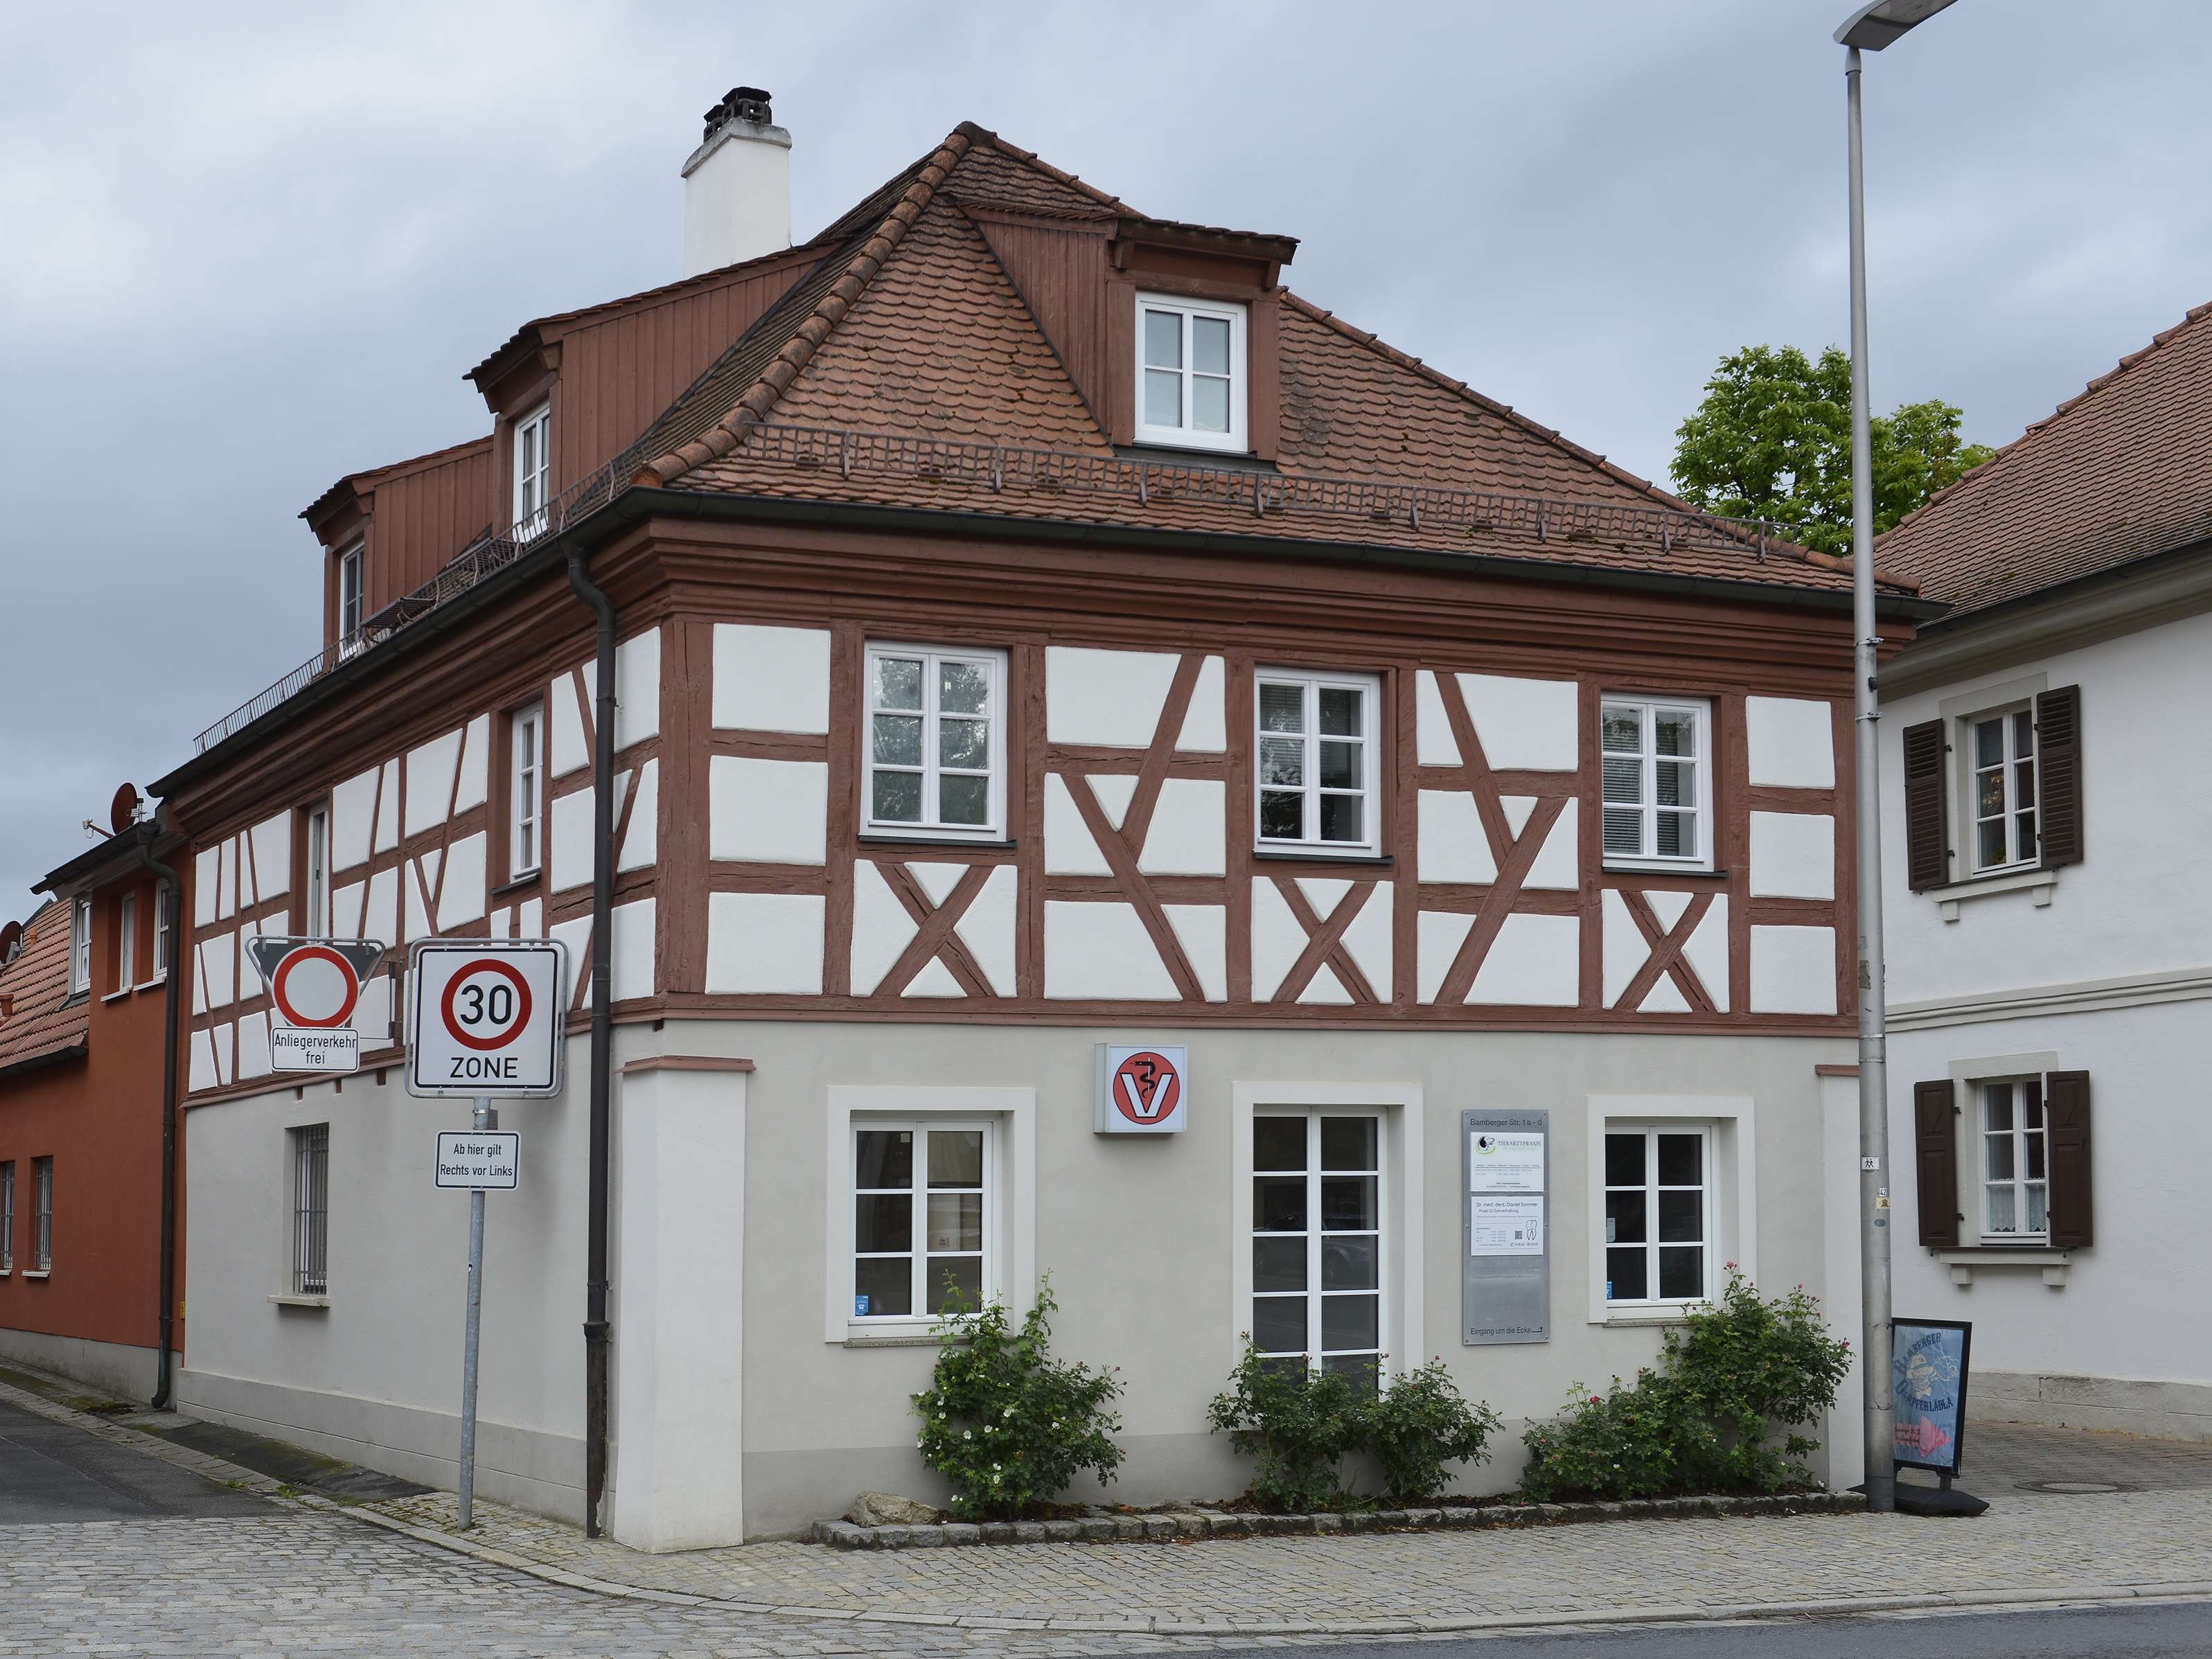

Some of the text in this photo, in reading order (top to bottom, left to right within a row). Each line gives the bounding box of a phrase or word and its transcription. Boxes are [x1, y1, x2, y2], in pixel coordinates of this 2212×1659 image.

[460, 984, 513, 1025] 30
[274, 1033, 357, 1049] Anliegerverkehr
[306, 1051, 326, 1065] frei
[450, 1057, 518, 1079] ZONE
[1470, 1119, 1507, 1127] Bamberger
[453, 1144, 502, 1157] Ab hier gilt
[440, 1163, 513, 1177] Rechts vor Links
[1470, 1328, 1494, 1336] Eingang
[1893, 1333, 1941, 1376] BAMBERGER
